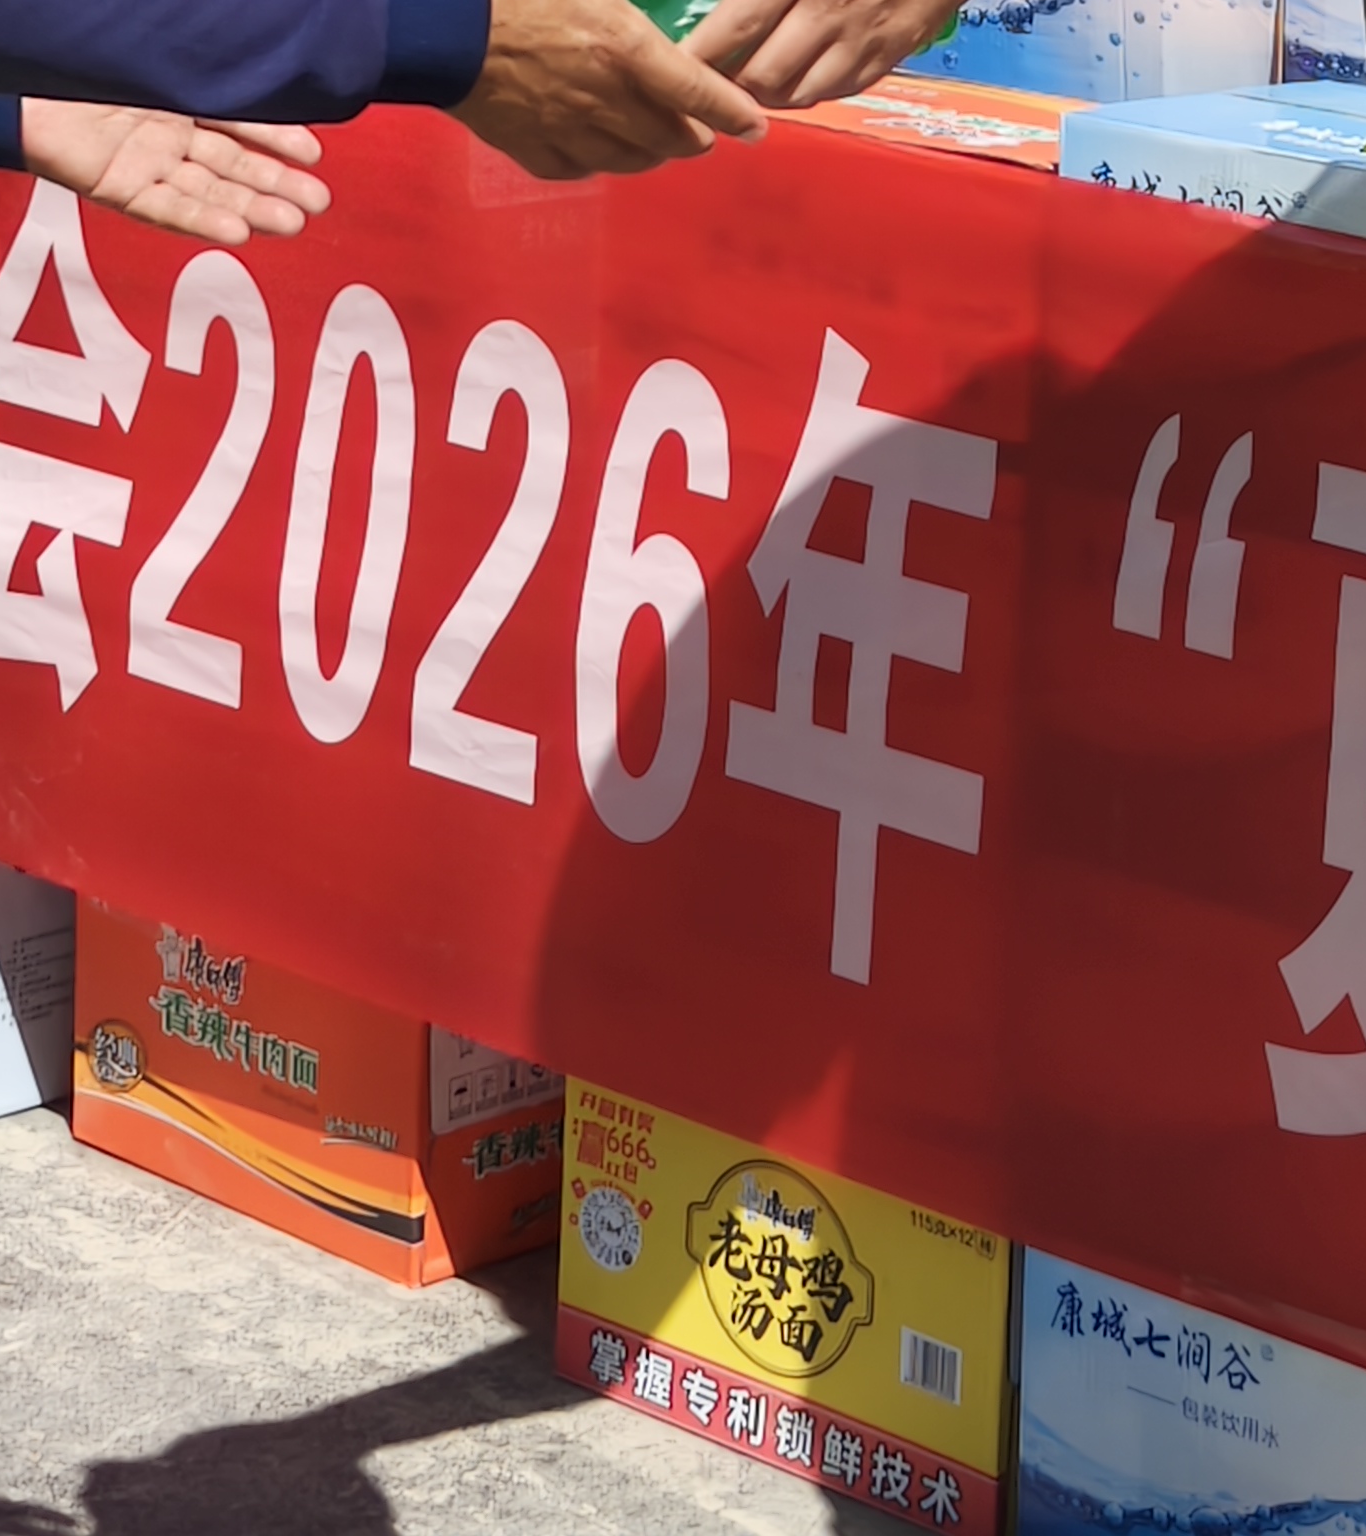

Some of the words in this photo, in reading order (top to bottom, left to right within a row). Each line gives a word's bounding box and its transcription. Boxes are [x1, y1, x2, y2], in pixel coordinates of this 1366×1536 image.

[148, 984, 320, 1095] 香辣牛肉面
[708, 1210, 854, 1323] 老母鸡
[730, 1287, 824, 1362] 汤面
[589, 1328, 961, 1526] 掌握专利锁鲜技术
